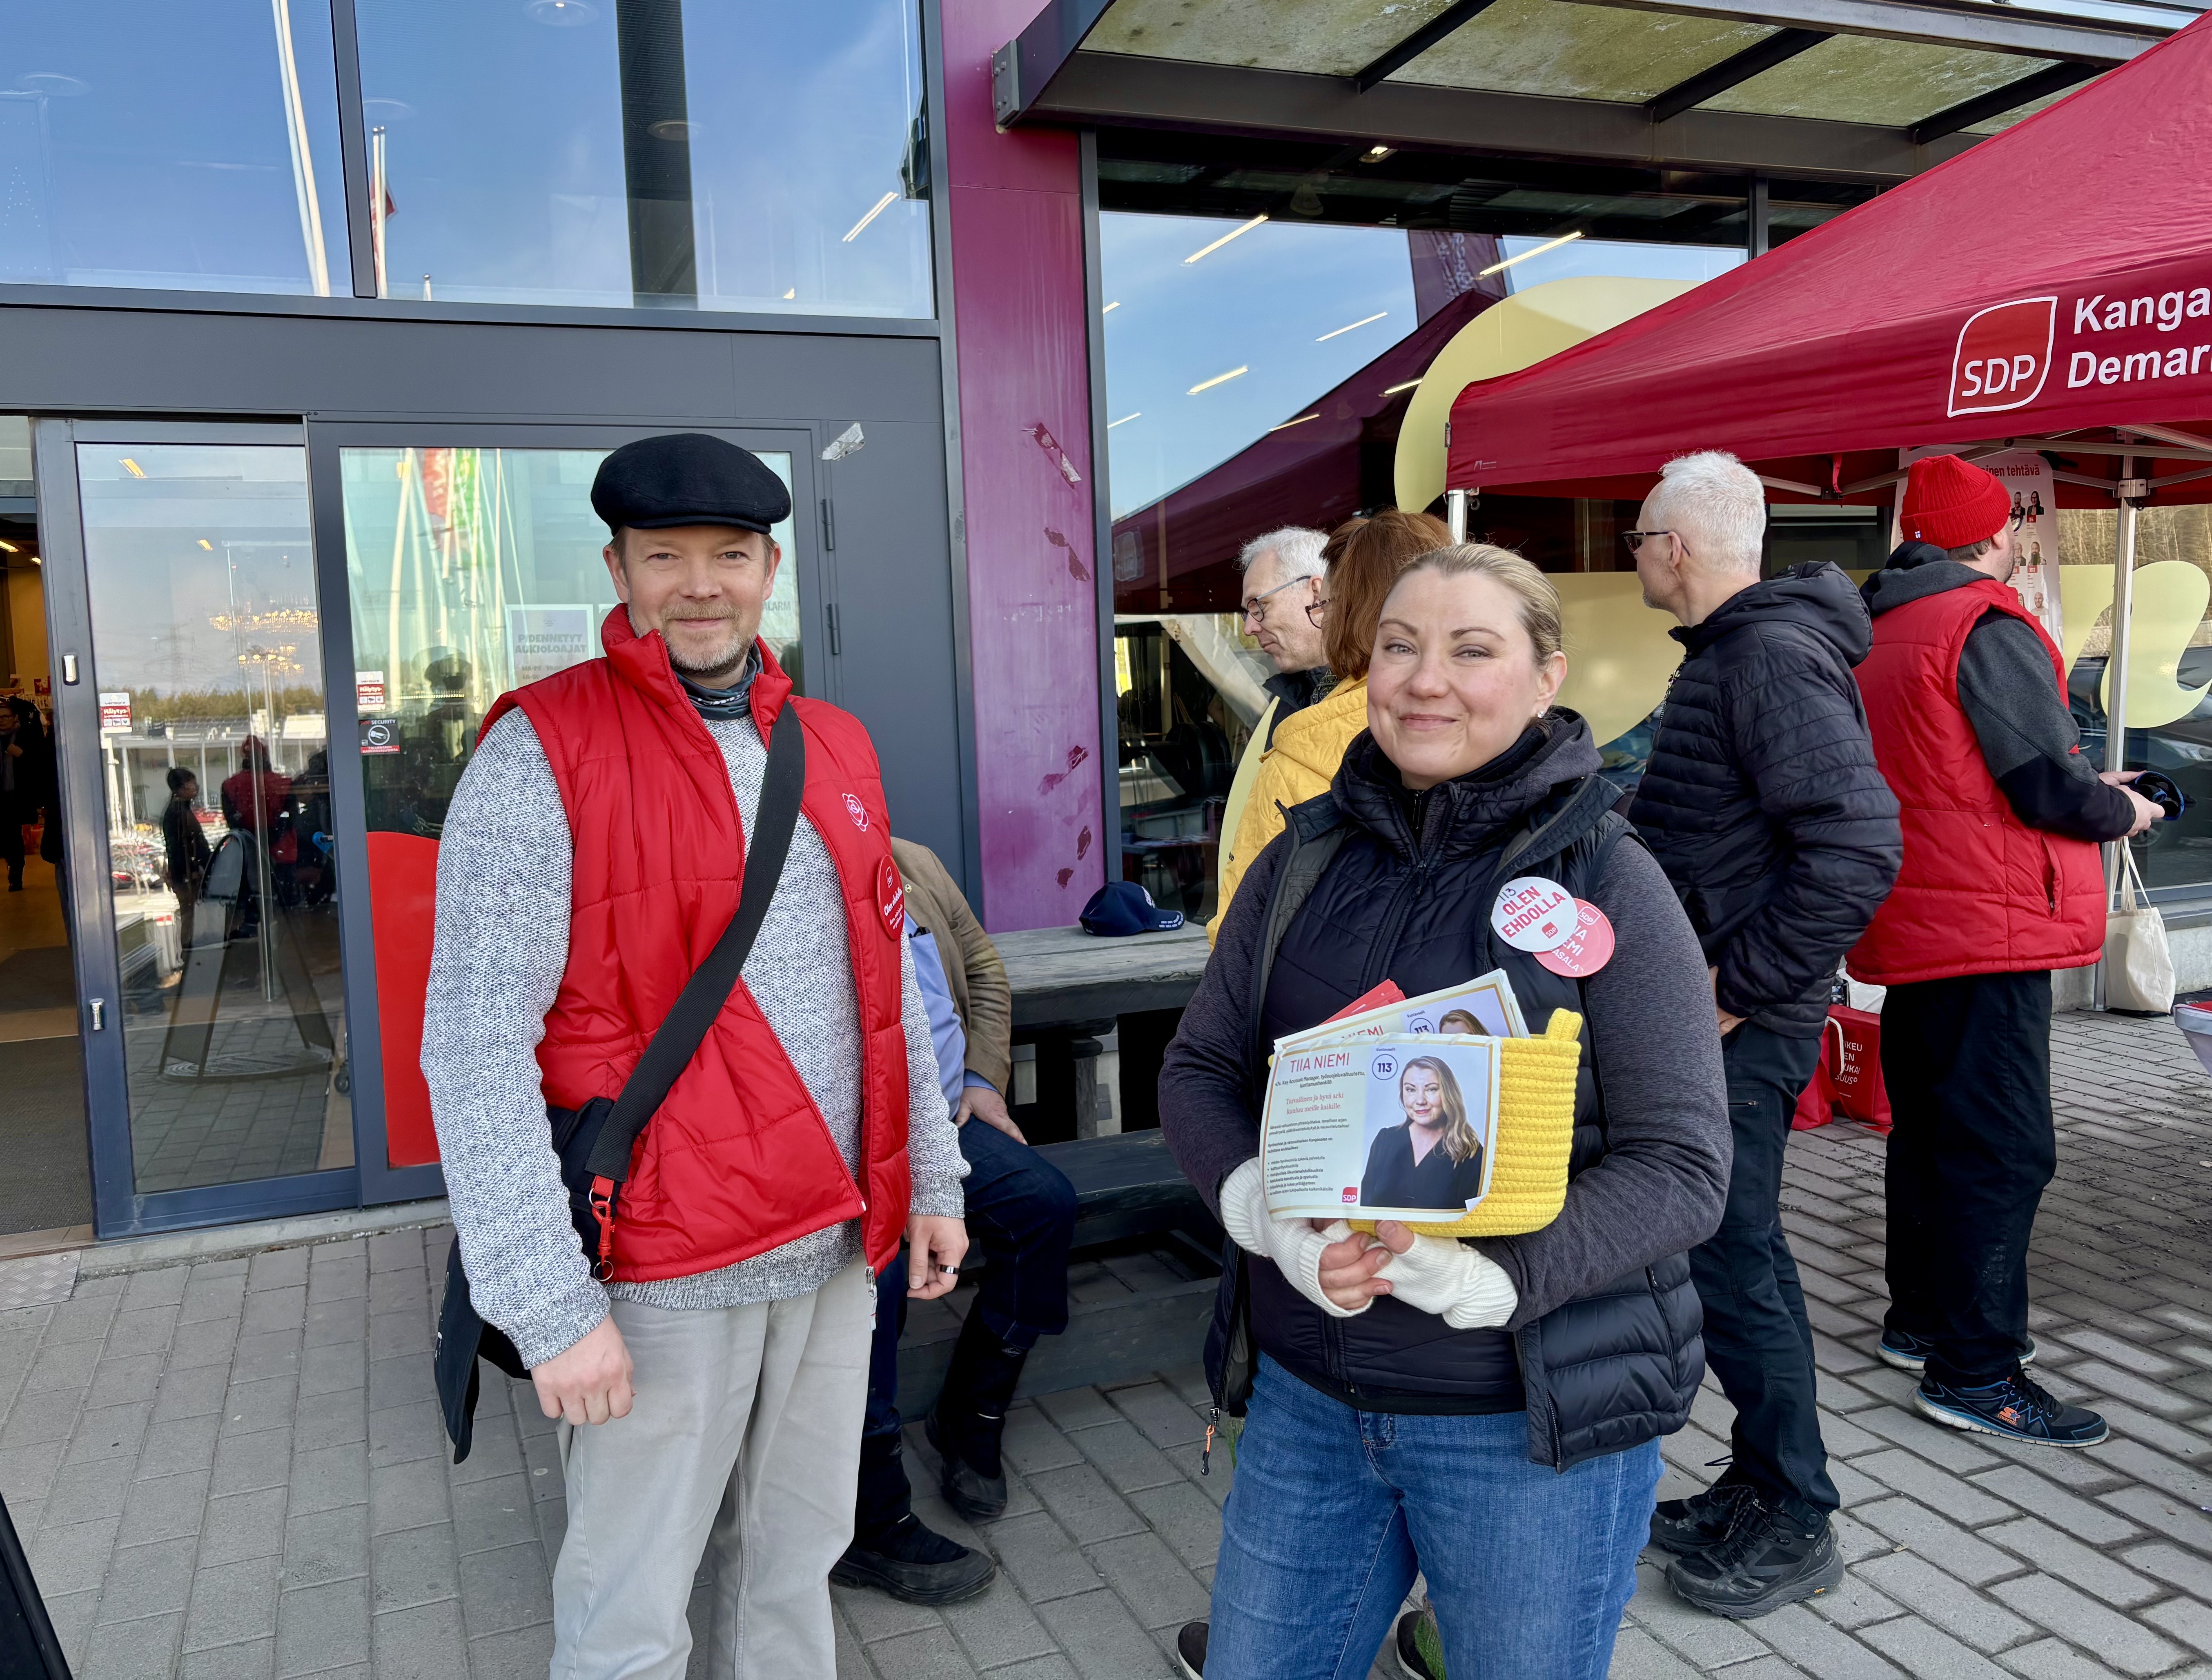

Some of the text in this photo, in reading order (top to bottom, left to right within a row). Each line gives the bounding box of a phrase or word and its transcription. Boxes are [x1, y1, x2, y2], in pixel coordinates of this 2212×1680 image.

[2074, 287, 2211, 334] Kanga
[2067, 345, 2212, 388] Demar
[1962, 354, 2036, 397] SDP
[1980, 464, 2040, 476] inen tehtävä
[515, 645, 587, 654] AUKIOLOAJAT
[1498, 888, 1516, 901] 113
[1503, 886, 1541, 915] OLEN
[1501, 892, 1566, 938] EHDOLLA
[1579, 912, 1593, 922] SDP
[1546, 927, 1556, 936] SDP
[1552, 949, 1579, 972] ASALA
[1415, 1025, 1429, 1034] 113
[1843, 1040, 1862, 1052] IKEU
[1844, 1052, 1855, 1061] EN
[1290, 1053, 1350, 1073] TIIA NIEMI
[1377, 1063, 1392, 1073] 113
[1844, 1063, 1860, 1075] UKAI
